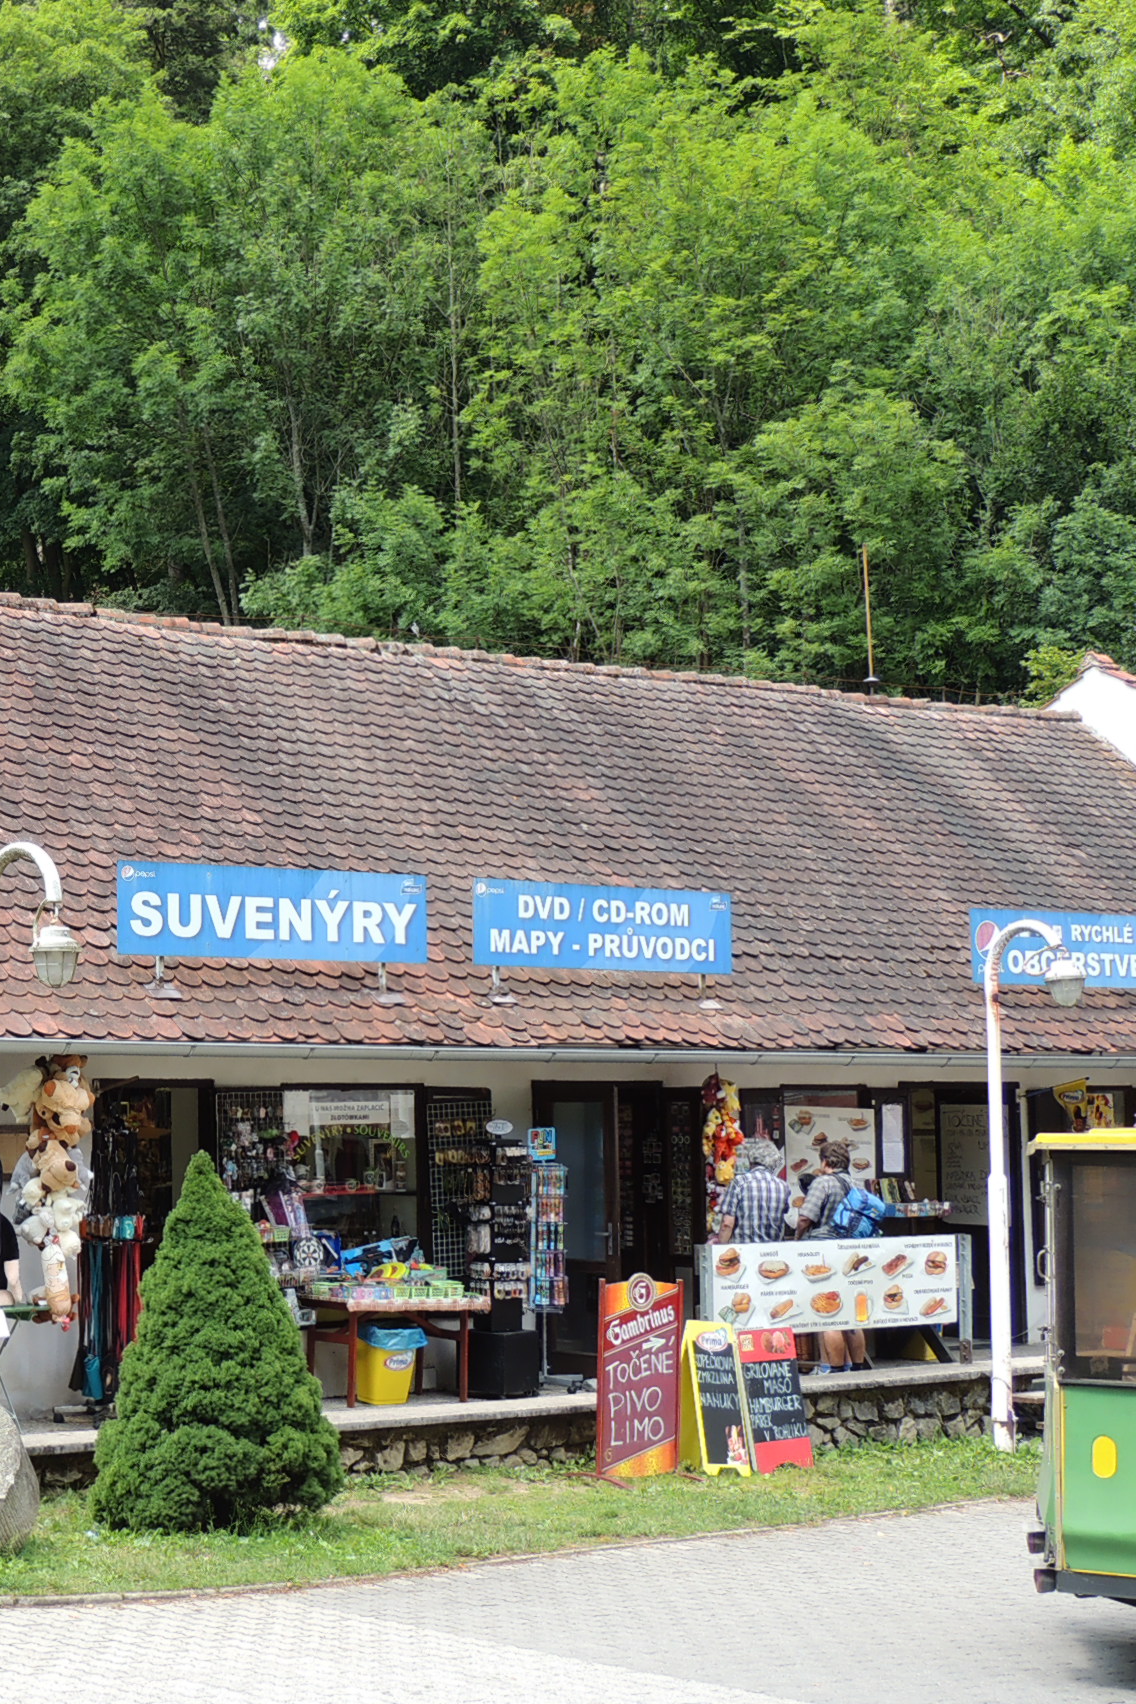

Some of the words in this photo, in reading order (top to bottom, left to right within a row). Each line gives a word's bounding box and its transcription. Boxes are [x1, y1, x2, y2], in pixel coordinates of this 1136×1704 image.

[129, 889, 417, 945] SUVENÝRY
[517, 894, 571, 921] DVD
[592, 898, 690, 927] CD-ROM
[489, 928, 565, 956] MAPY
[588, 927, 715, 962] PRŮVODCI
[1070, 923, 1134, 944] RYCHLÉ
[606, 1305, 675, 1346] Gambrinus
[701, 1335, 723, 1346] Prima
[605, 1336, 675, 1390] TOČENÉ
[608, 1386, 662, 1418] PIVO
[763, 1377, 792, 1395] MASO
[748, 1394, 803, 1414] HAMBURGER
[610, 1416, 665, 1446] LIMO
